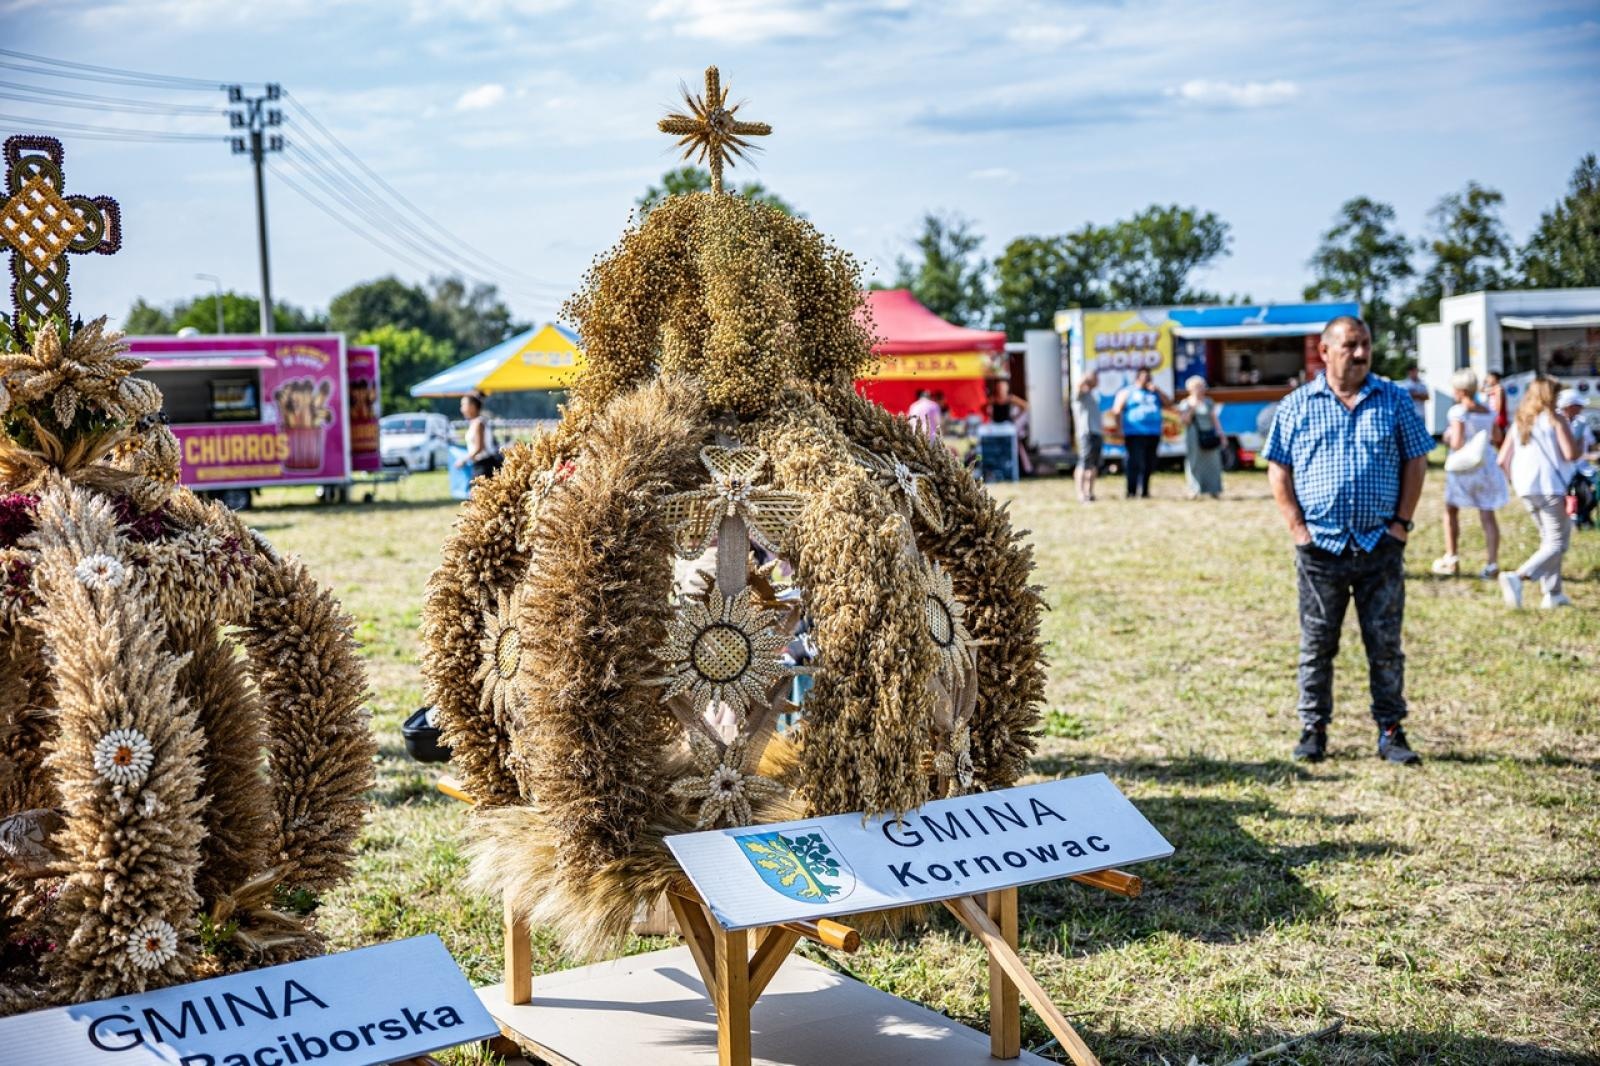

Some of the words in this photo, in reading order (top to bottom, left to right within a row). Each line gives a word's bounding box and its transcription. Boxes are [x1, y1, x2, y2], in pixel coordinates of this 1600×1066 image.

[185, 433, 290, 465] CHURROS
[882, 798, 1067, 847] GMINA
[887, 835, 1110, 887] Kornowac
[87, 979, 329, 1052] GMINA
